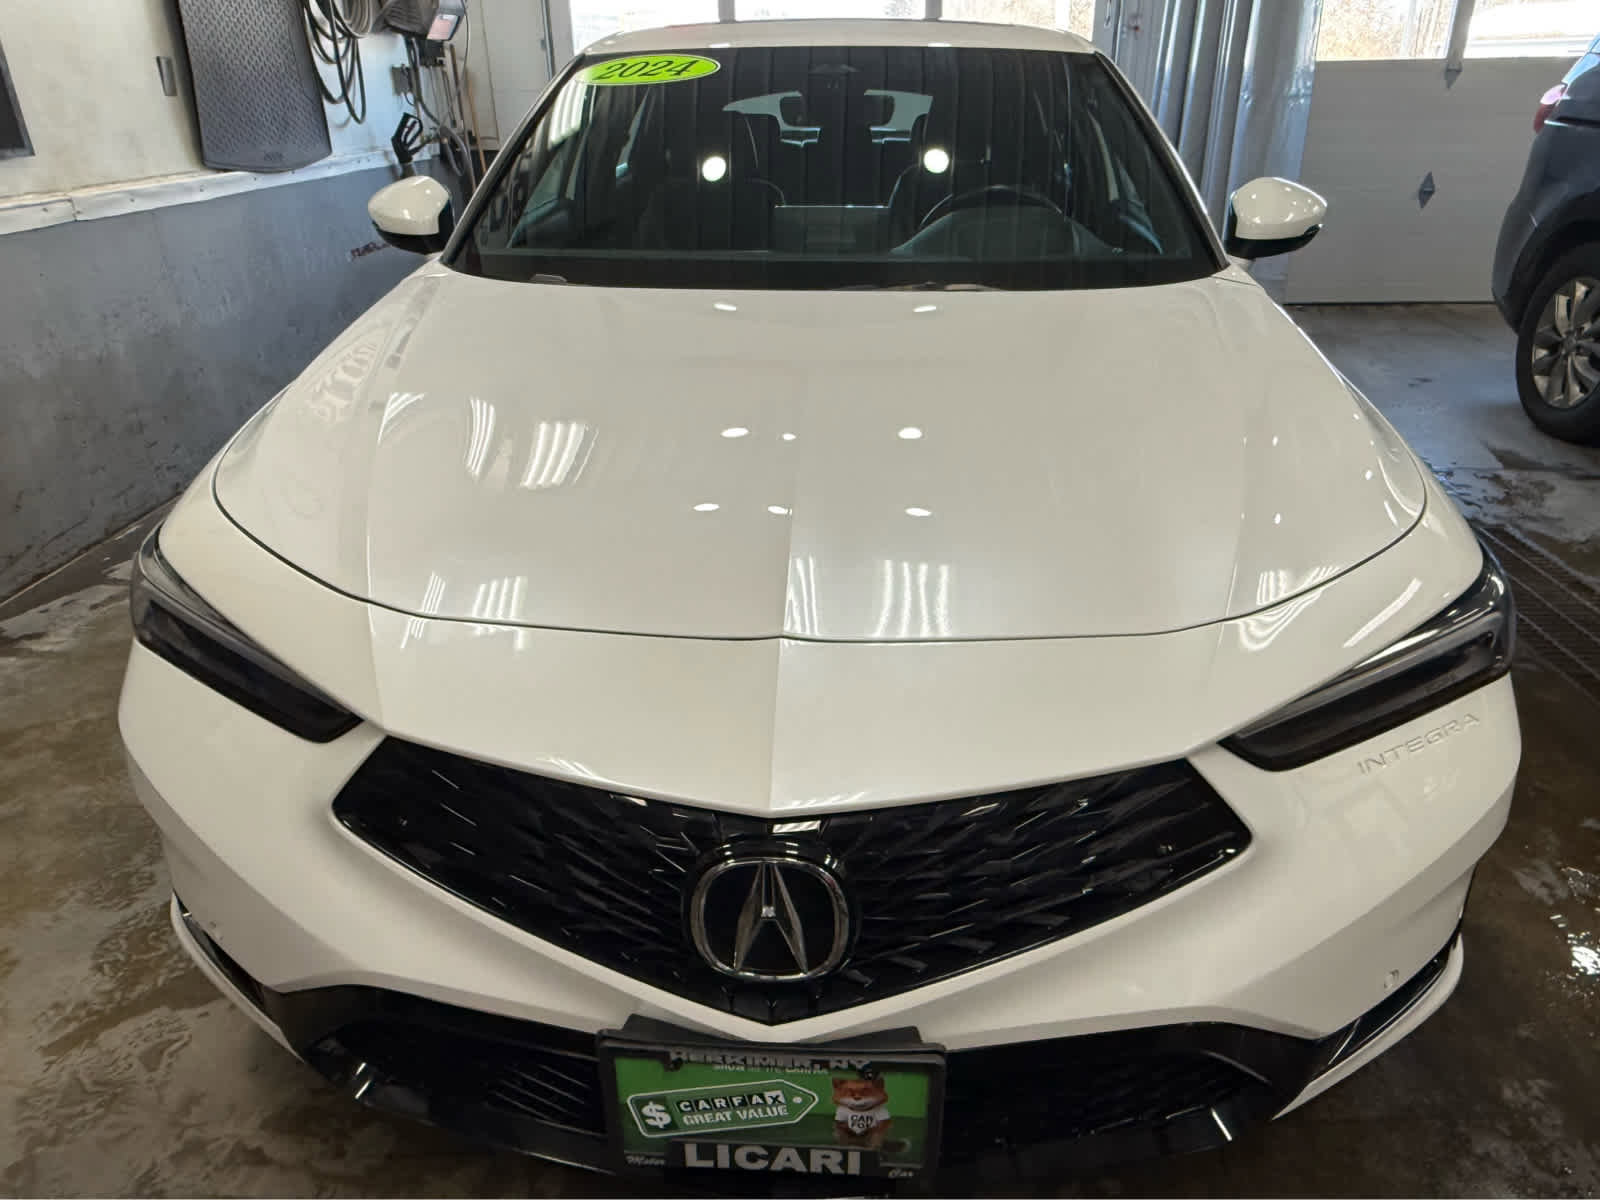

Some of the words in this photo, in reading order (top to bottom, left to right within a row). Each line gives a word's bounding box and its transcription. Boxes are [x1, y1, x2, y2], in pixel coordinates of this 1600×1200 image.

[592, 59, 699, 81] 2024
[1356, 713, 1480, 774] INTEGRA
[678, 1091, 785, 1112] CARFAX
[683, 1109, 732, 1126] GREAT
[735, 1103, 789, 1121] VALUE
[685, 1143, 861, 1175] LICARI
